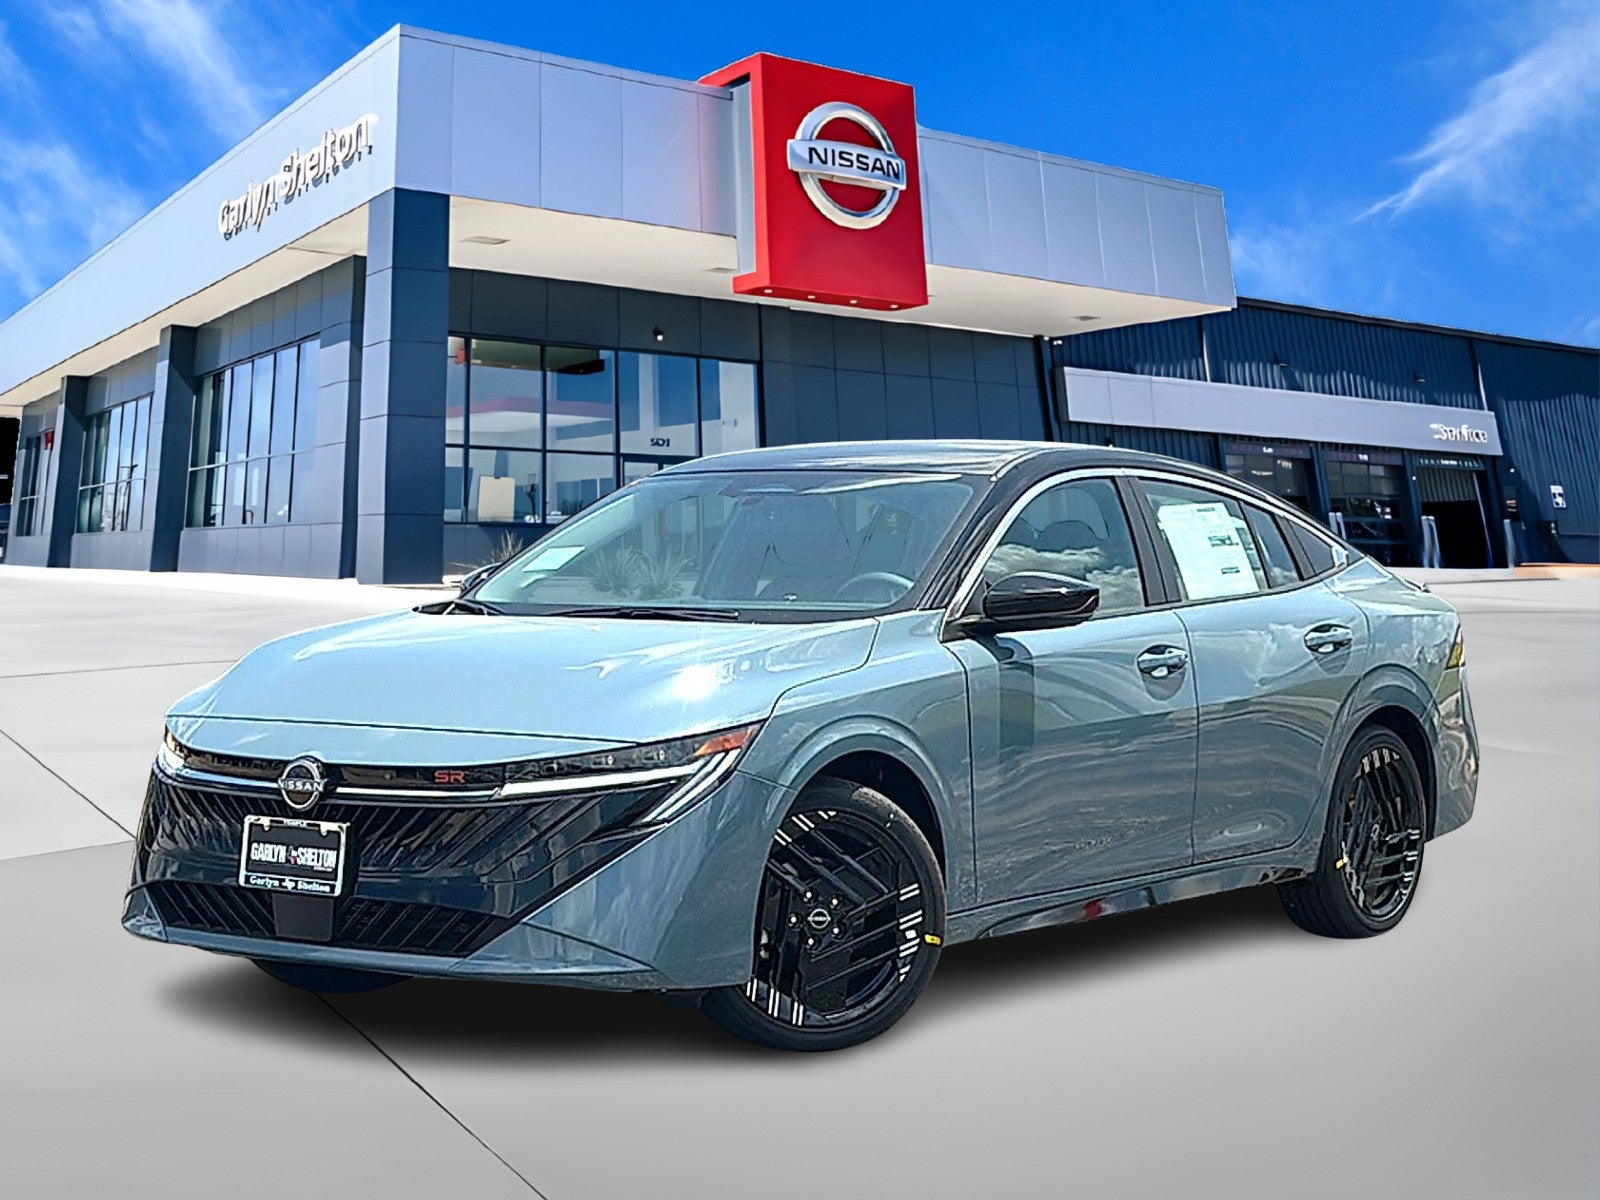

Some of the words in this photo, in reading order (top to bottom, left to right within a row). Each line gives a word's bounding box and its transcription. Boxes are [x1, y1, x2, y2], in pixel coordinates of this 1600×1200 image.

[278, 114, 374, 200] Shelton
[808, 146, 900, 181] NISSAN
[279, 779, 325, 792] NISSAN
[434, 769, 466, 784] SR
[250, 842, 287, 863] GARLYN
[297, 846, 338, 869] SHELTON
[249, 875, 280, 889] Garlyn
[297, 880, 331, 893] Shelton
